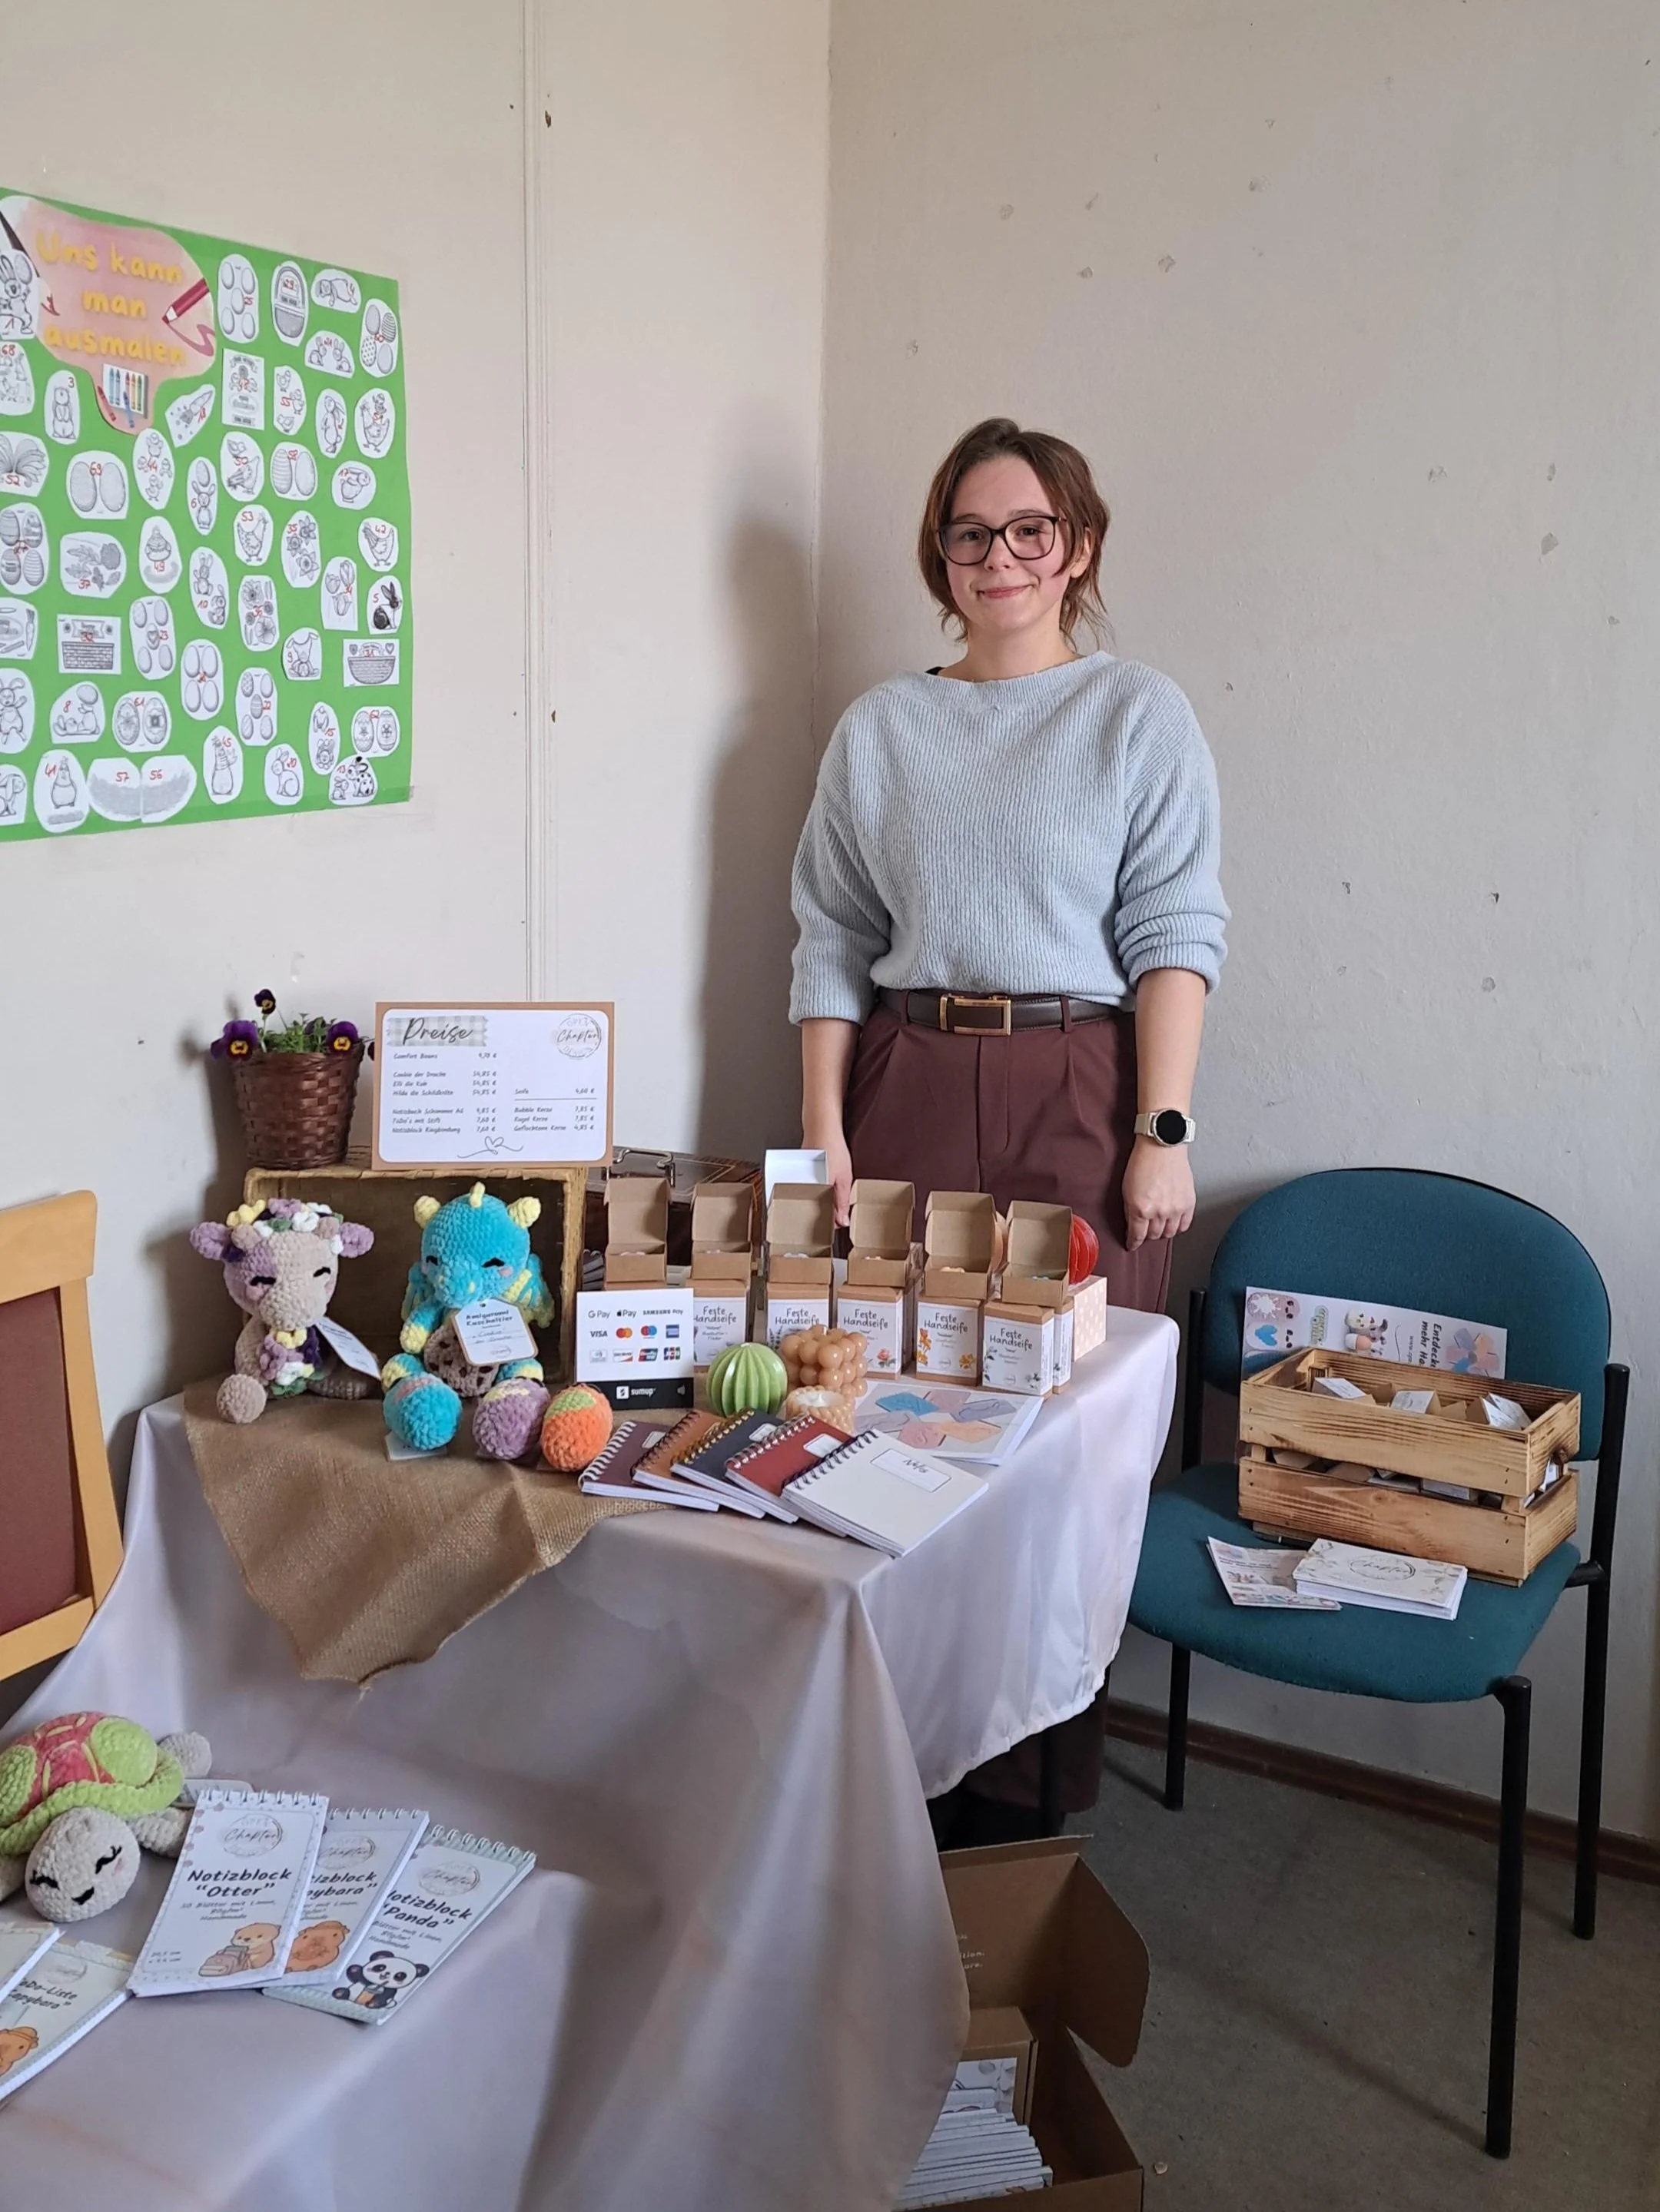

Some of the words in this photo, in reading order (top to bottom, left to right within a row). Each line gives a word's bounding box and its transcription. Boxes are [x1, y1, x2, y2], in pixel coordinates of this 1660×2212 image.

[35, 230, 98, 270] Uns
[110, 242, 182, 284] kann
[81, 290, 145, 319] man
[44, 323, 186, 366] ausmalen
[68, 376, 75, 388] 3
[191, 498, 198, 509] 6
[241, 511, 254, 522] 53
[63, 700, 71, 713] 8
[115, 771, 130, 782] 57
[150, 769, 163, 781] 56
[403, 1016, 473, 1045] Preise
[597, 1309, 611, 1318] Pay
[622, 1308, 637, 1318] Pay
[703, 1305, 725, 1316] Feste
[786, 1308, 809, 1317] Feste
[855, 1308, 877, 1319] Feste
[694, 1312, 737, 1325] Handseife
[775, 1315, 819, 1325] Handseife
[843, 1316, 888, 1330] Handseife
[935, 1312, 957, 1323] Feste
[924, 1320, 968, 1334] Handseife
[1001, 1328, 1021, 1339] Feste
[990, 1335, 1033, 1351] Handseife
[631, 1388, 654, 1397] sumup
[187, 1868, 292, 1882] Notizblock
[19, 1977, 78, 1999] oDo-Liste
